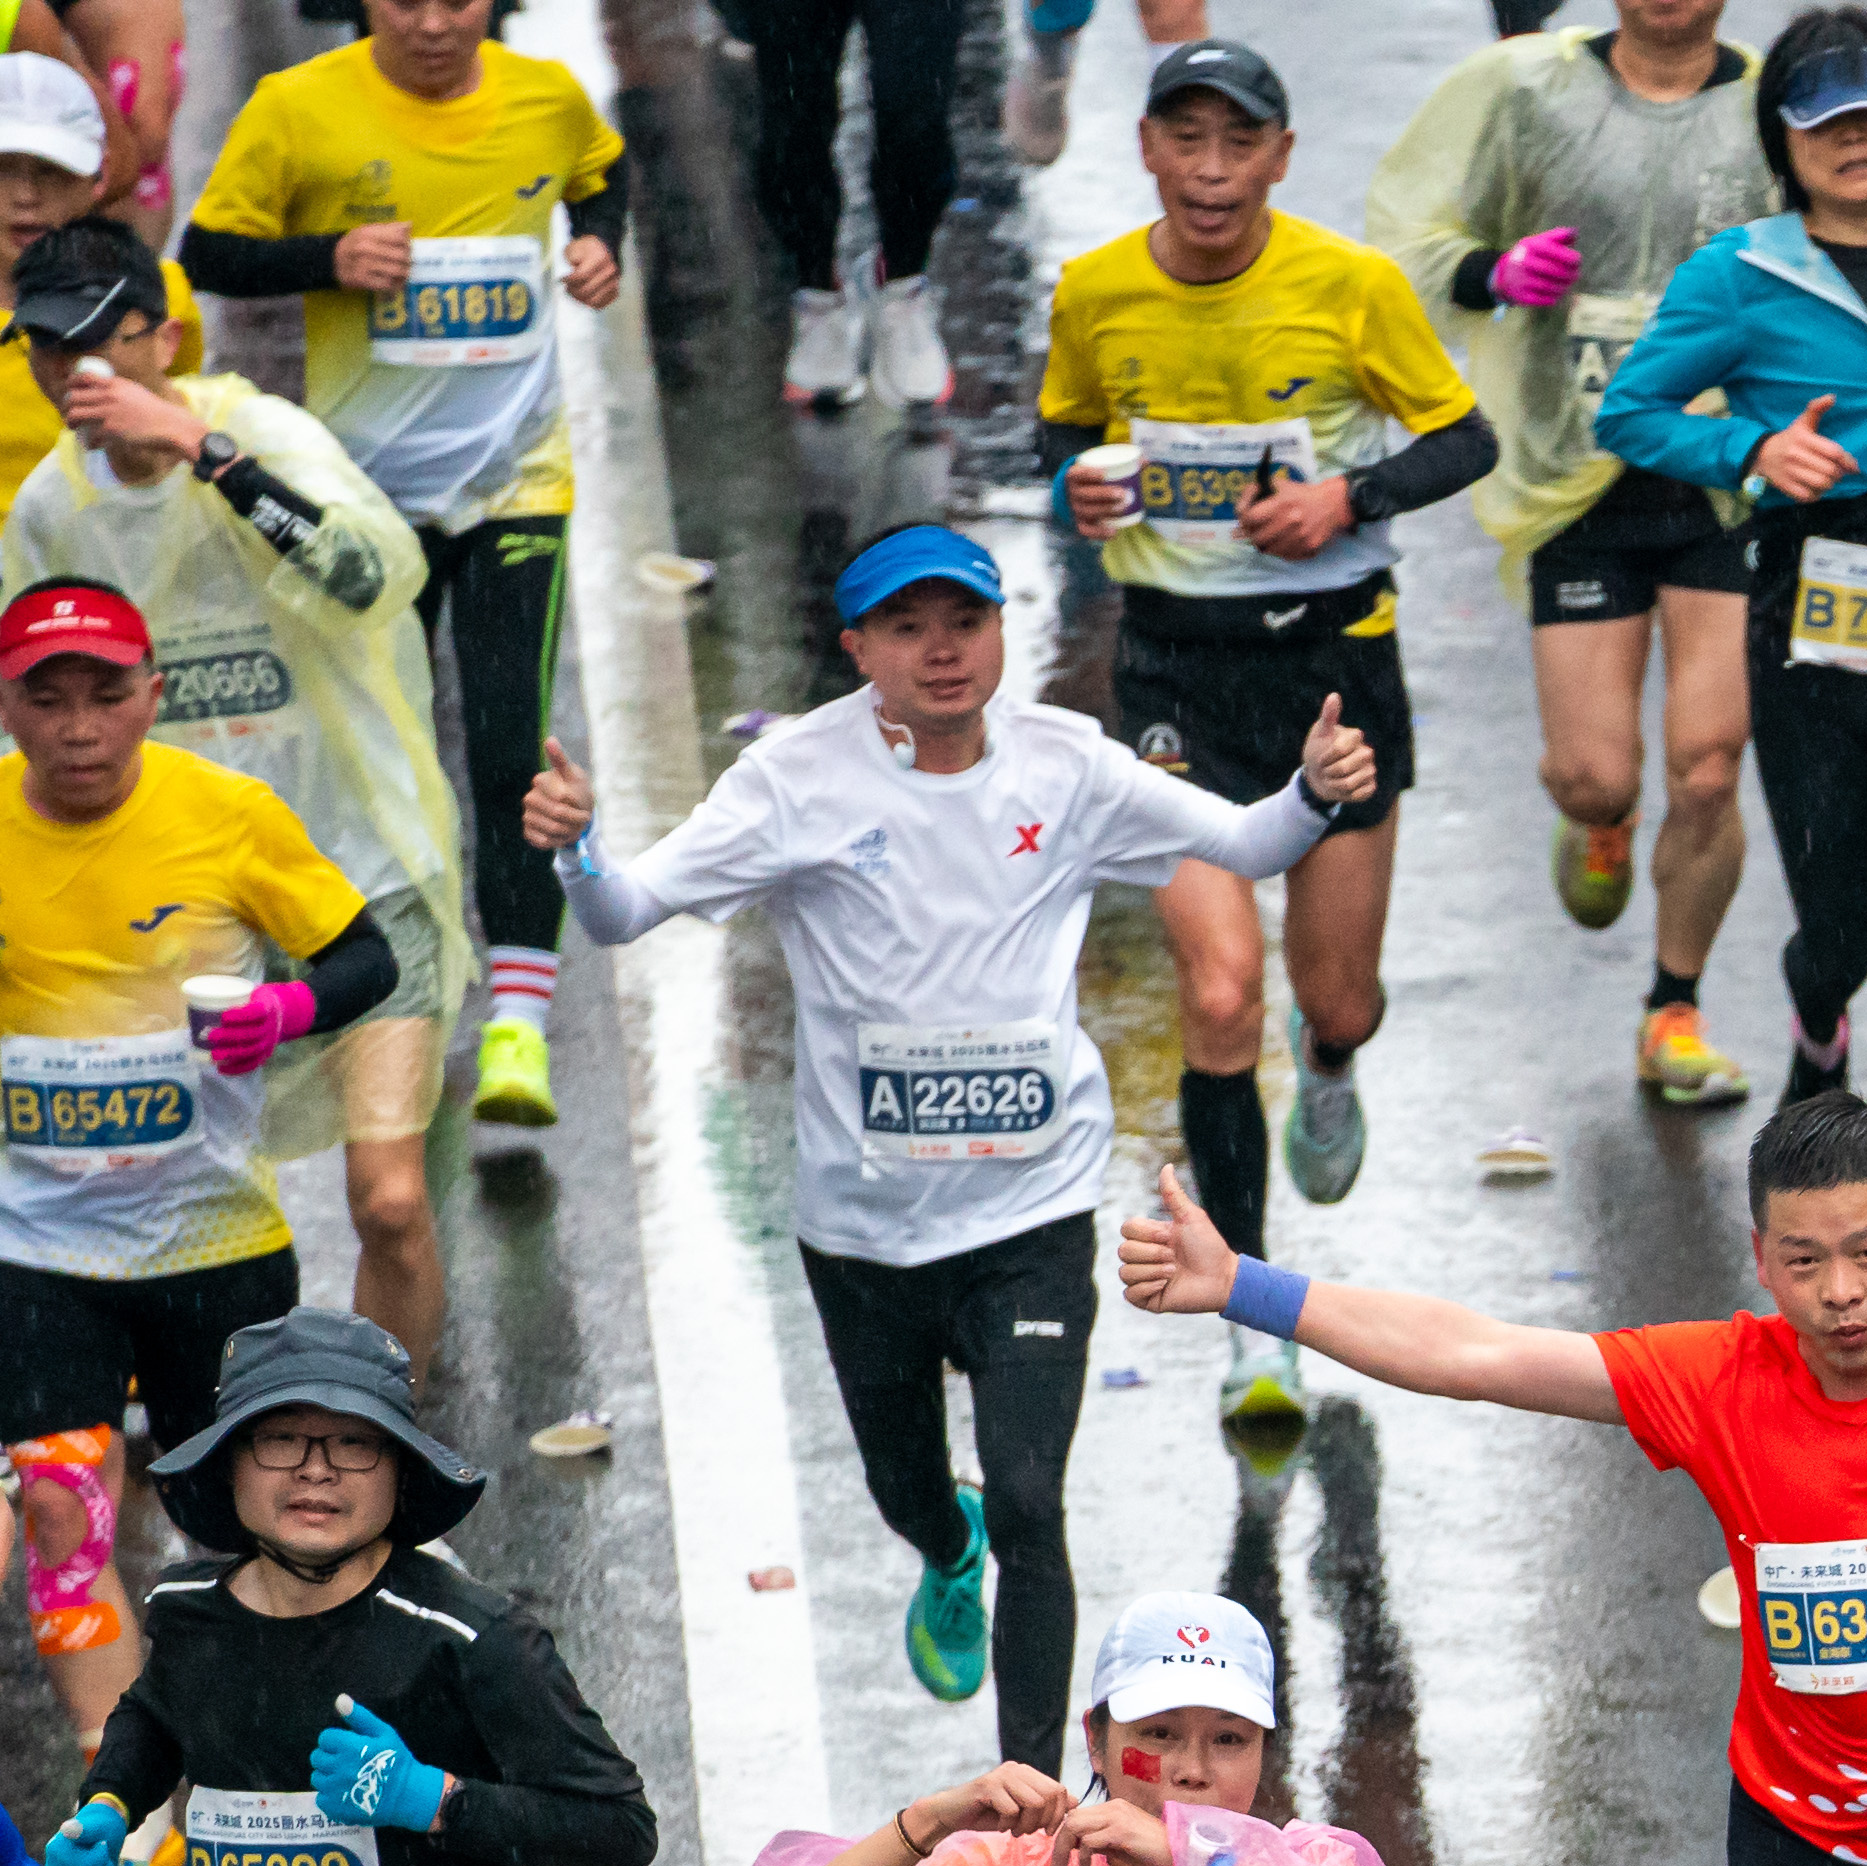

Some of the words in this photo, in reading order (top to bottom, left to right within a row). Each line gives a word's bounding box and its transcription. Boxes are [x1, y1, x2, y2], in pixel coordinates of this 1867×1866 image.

[418, 283, 529, 323] 61819
[1141, 465, 1173, 506] B
[1804, 588, 1835, 628] B
[8, 1087, 41, 1132] B
[53, 1085, 182, 1130] 65472
[869, 1075, 902, 1120] A
[913, 1072, 1044, 1116] 22626
[1765, 1600, 1802, 1650] B
[1163, 1655, 1226, 1668] KUAI
[248, 1815, 344, 1829] 2025丽水马
